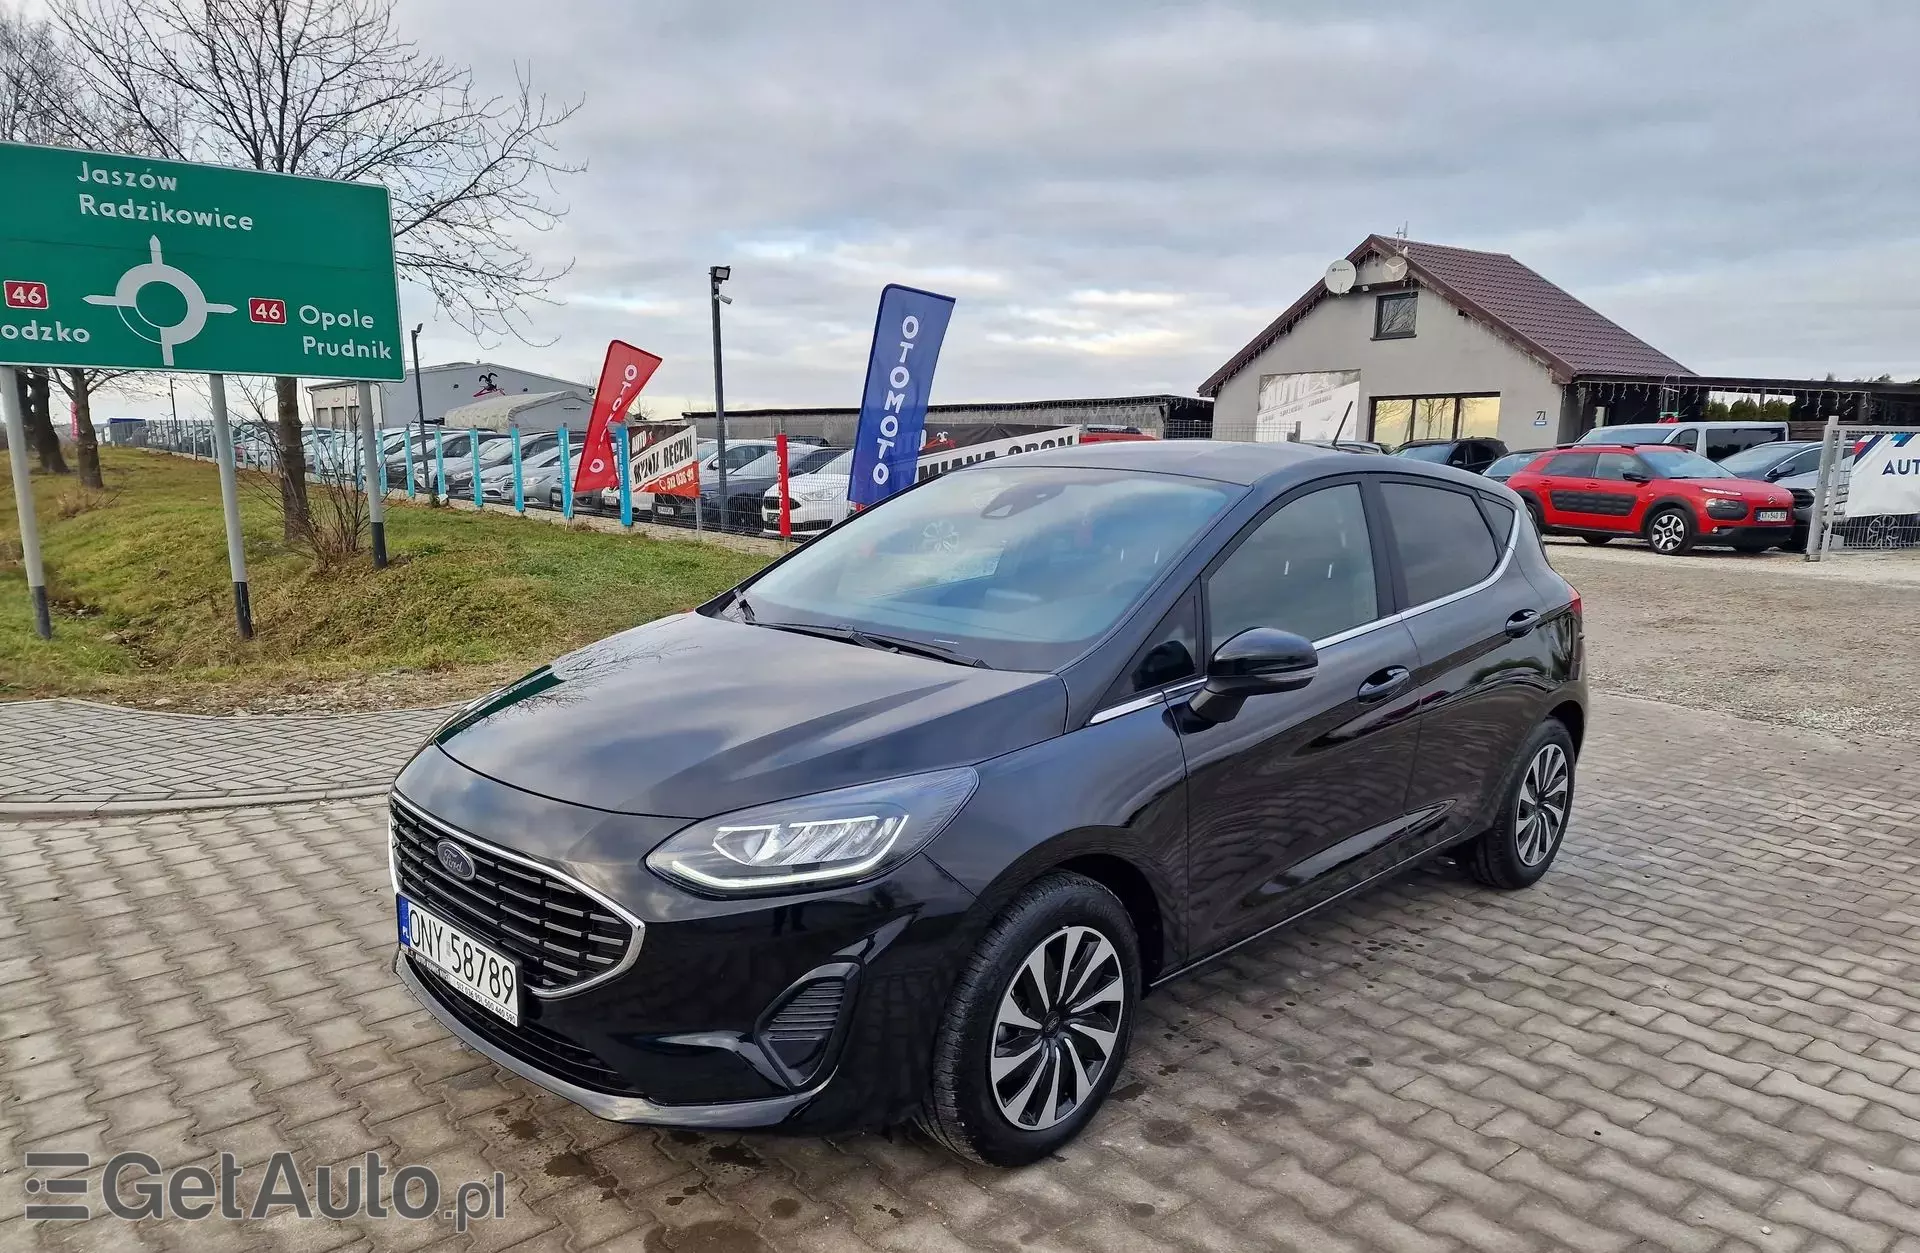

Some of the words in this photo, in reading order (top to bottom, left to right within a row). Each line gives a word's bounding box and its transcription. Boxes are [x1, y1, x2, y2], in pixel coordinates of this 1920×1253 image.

[77, 161, 177, 191] Jaszów
[79, 193, 253, 231] Radzikowice
[12, 286, 42, 305] 46
[255, 303, 281, 320] 46
[299, 304, 374, 331] Opole
[0, 319, 90, 343] odzko
[303, 335, 392, 360] Prudnik
[872, 315, 919, 485] OTOMOTO
[1536, 410, 1546, 421] 71
[1881, 459, 1920, 475] AUT
[402, 926, 410, 939] PL
[409, 909, 443, 963] ONY
[450, 932, 514, 1005] 58789
